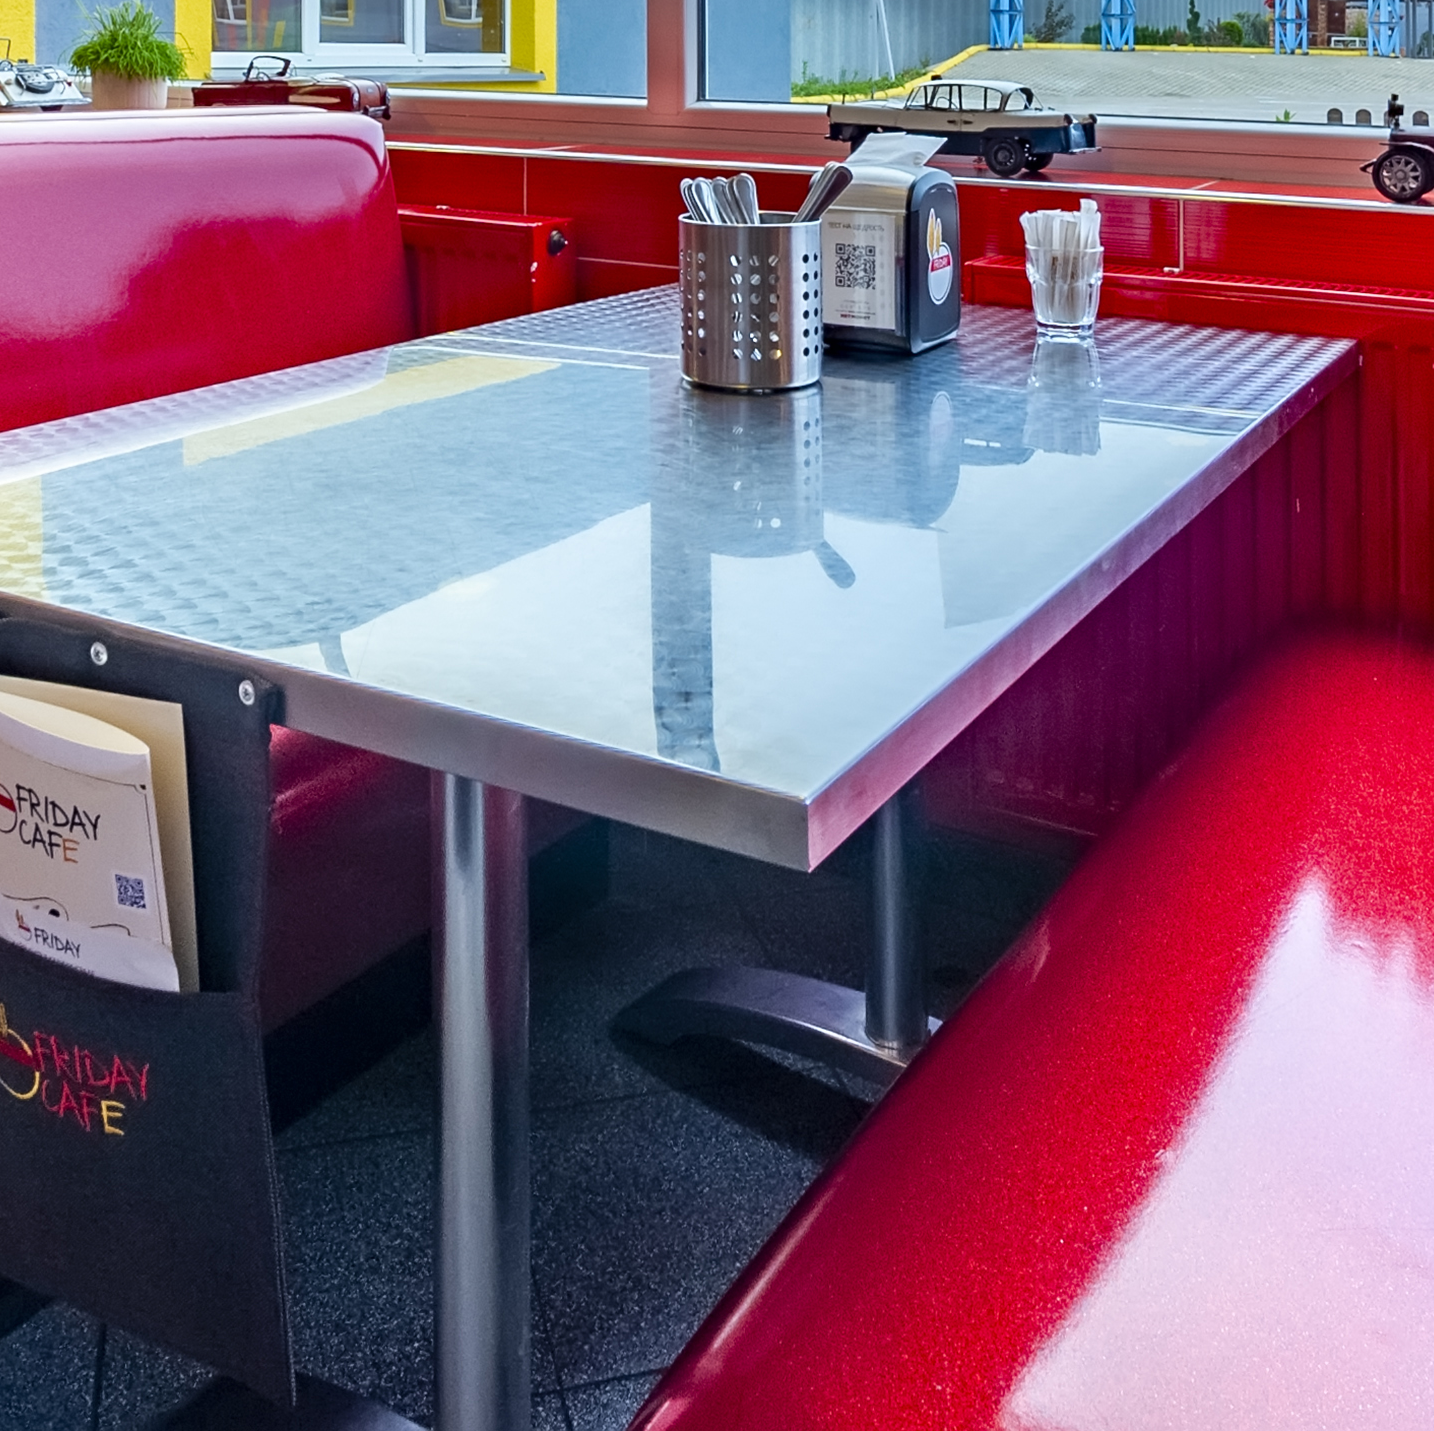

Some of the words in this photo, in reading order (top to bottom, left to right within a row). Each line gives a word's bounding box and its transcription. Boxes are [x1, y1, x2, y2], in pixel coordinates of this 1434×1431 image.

[15, 783, 101, 841] FRIDAY
[19, 819, 80, 864] CAFE
[33, 927, 81, 959] FRIDAY
[33, 1031, 150, 1102] FRIDAY
[41, 1079, 126, 1136] CAFE
